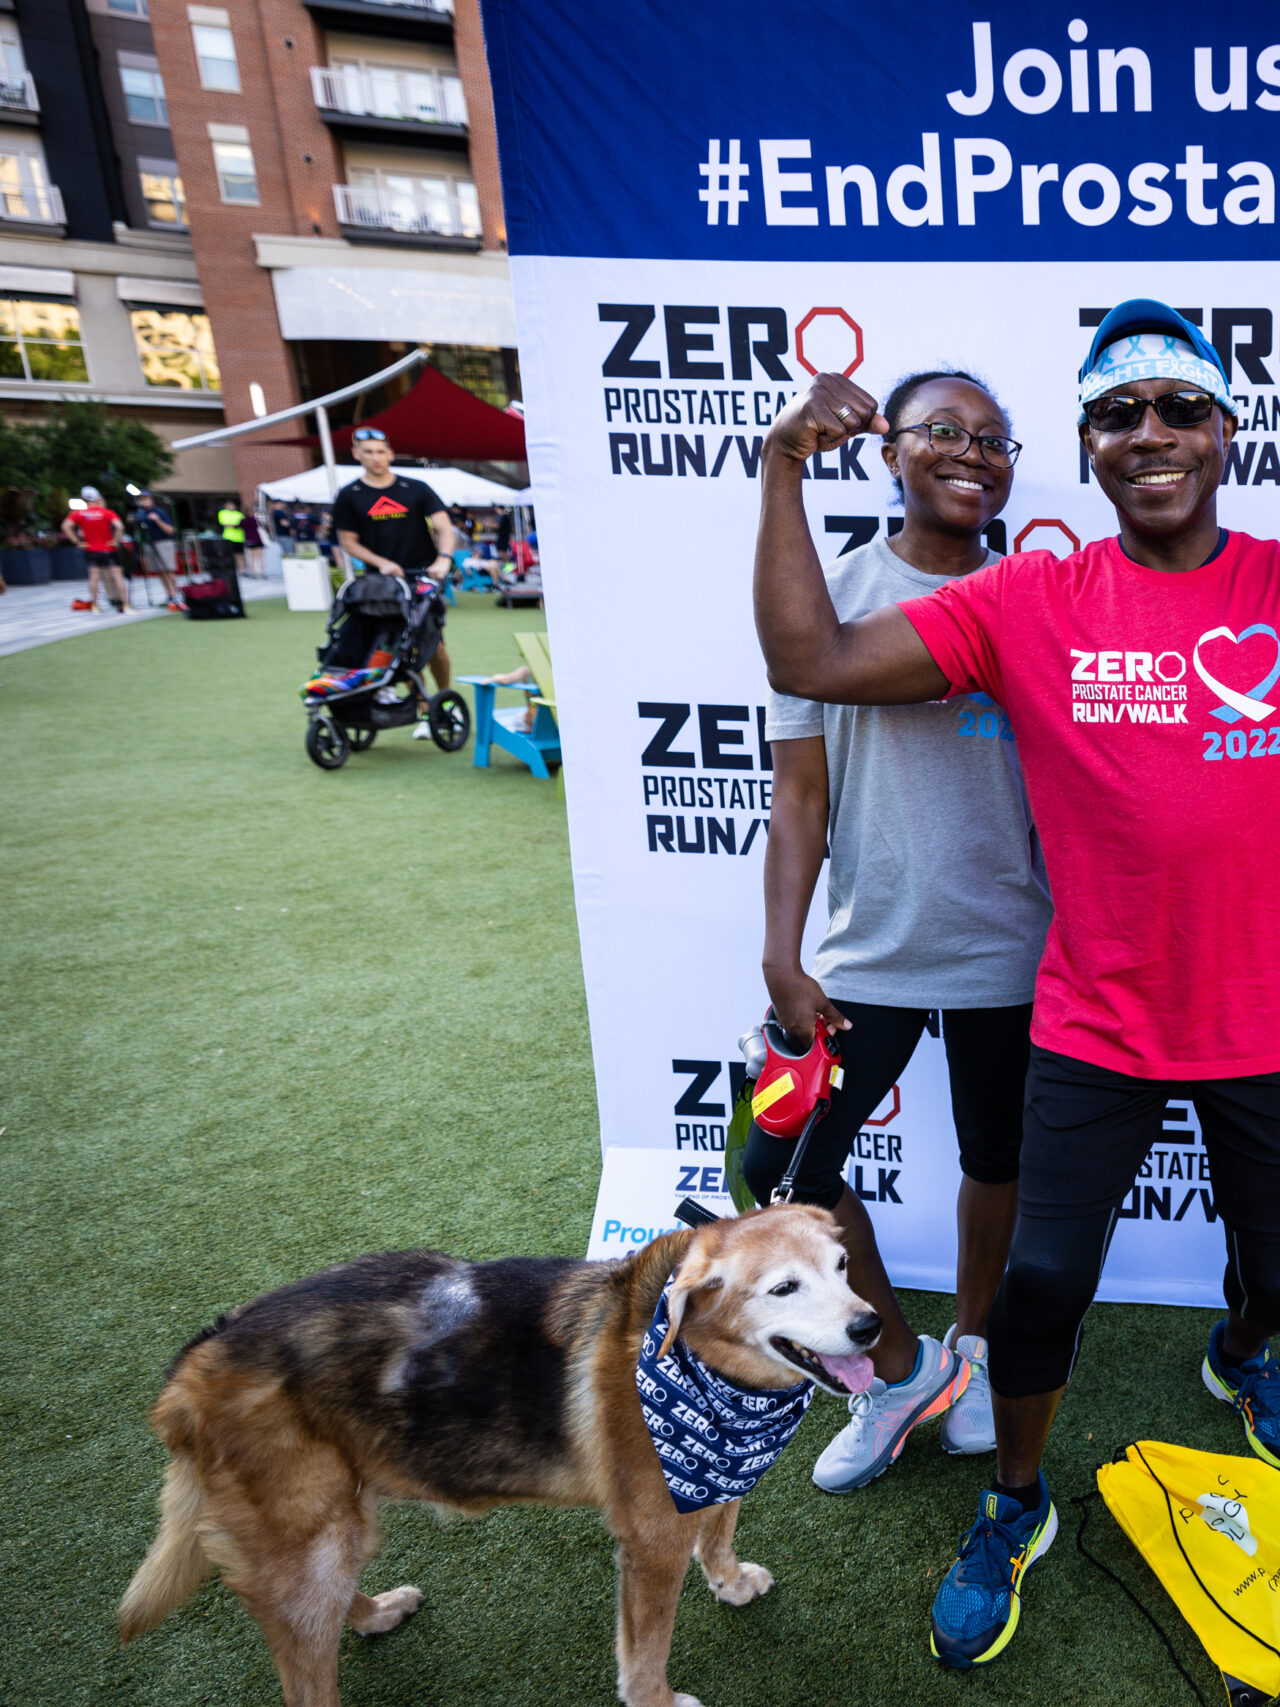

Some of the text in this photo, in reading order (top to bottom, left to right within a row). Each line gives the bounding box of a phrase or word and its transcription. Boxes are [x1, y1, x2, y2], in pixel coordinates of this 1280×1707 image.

[946, 18, 1152, 116] Join
[598, 303, 864, 382] ZERO
[604, 387, 747, 426] PROSTATE
[608, 432, 870, 481] RUN/WLK
[1070, 648, 1187, 682] ZERO
[1072, 683, 1188, 701] PROSTATE CANCER
[957, 711, 1016, 741] 202
[1072, 702, 1189, 724] RUN/WALK
[638, 701, 774, 771] ZE
[643, 775, 773, 810] PROSTATE
[675, 1166, 729, 1193] ZE
[1138, 1151, 1211, 1181] STATE
[635, 1365, 668, 1402] ERO
[641, 1405, 674, 1436] ERO
[671, 1401, 719, 1441] ZERO
[680, 1434, 730, 1468] ZERO
[738, 1447, 782, 1472] ZERO
[704, 1469, 756, 1491] ZERO
